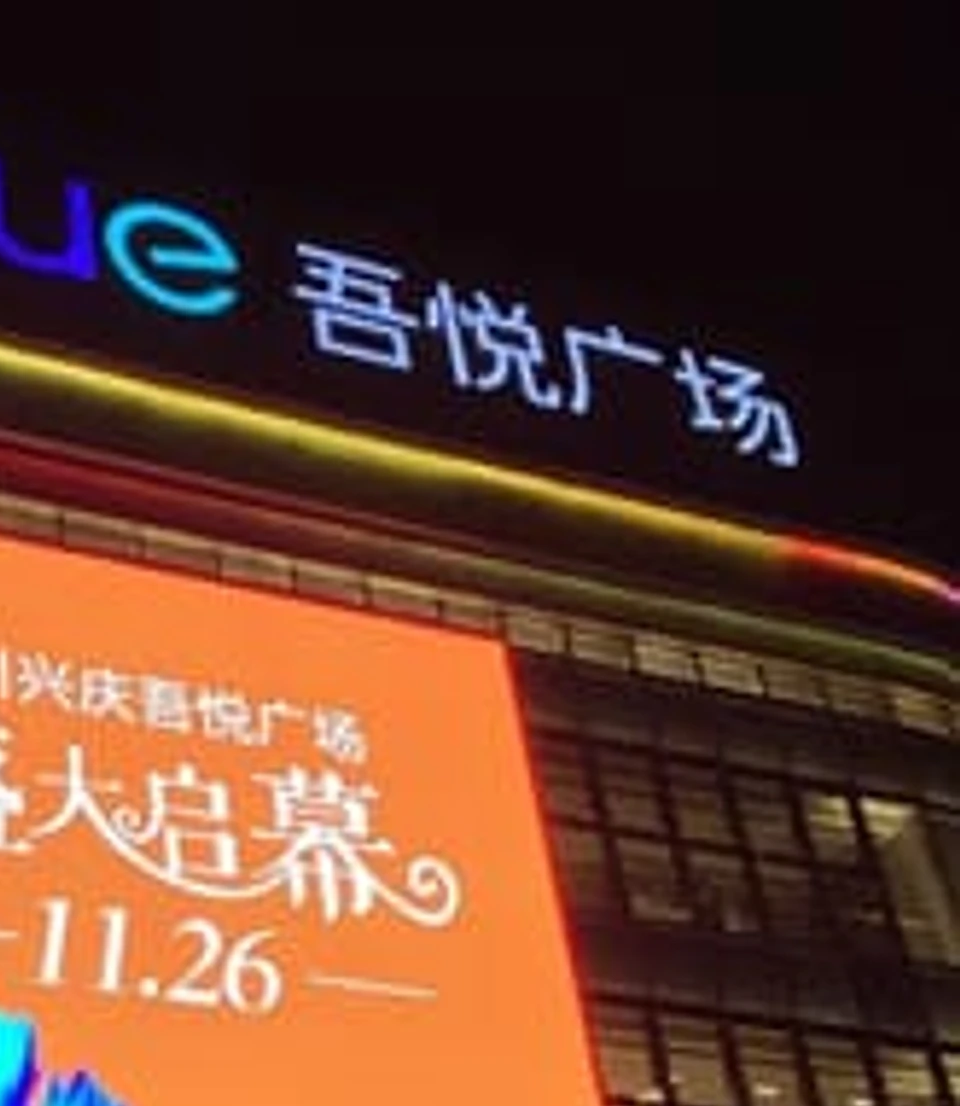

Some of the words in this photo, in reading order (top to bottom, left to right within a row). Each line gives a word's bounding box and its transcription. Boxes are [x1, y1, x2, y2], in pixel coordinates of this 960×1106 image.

[294, 243, 798, 466] 吾悦广场
[38, 898, 284, 1014] 11.26
